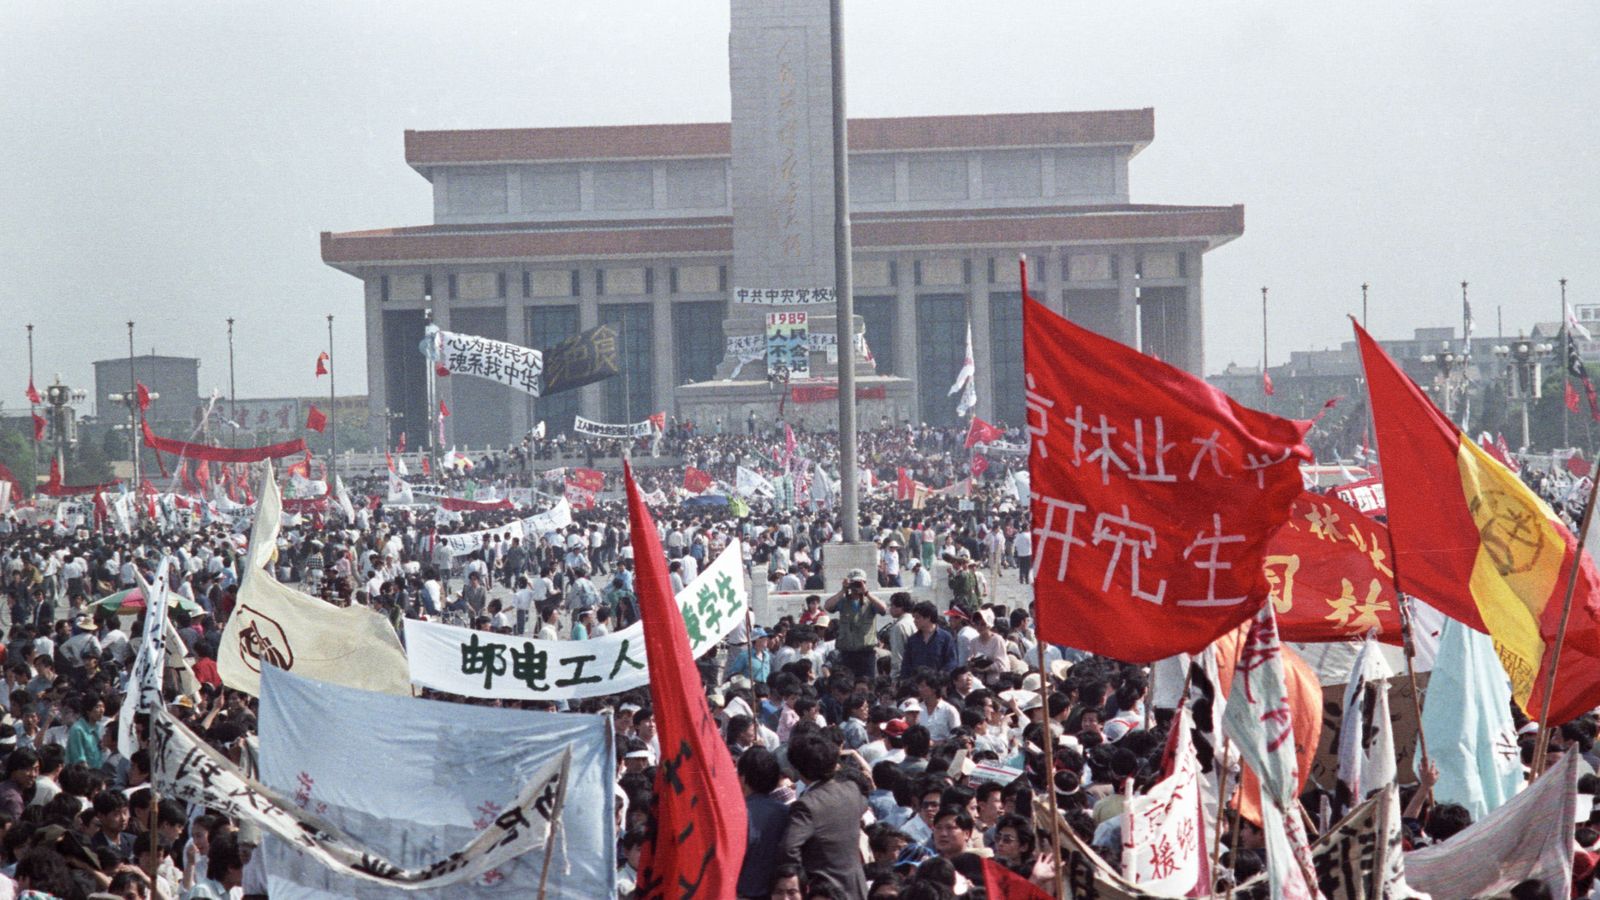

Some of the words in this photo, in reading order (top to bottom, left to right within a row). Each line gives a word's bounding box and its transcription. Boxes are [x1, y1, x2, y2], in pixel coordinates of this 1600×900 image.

[770, 312, 807, 325] 1989
[769, 328, 808, 341] 人民
[769, 343, 809, 358] 不会
[461, 633, 645, 691] 邮电工人
